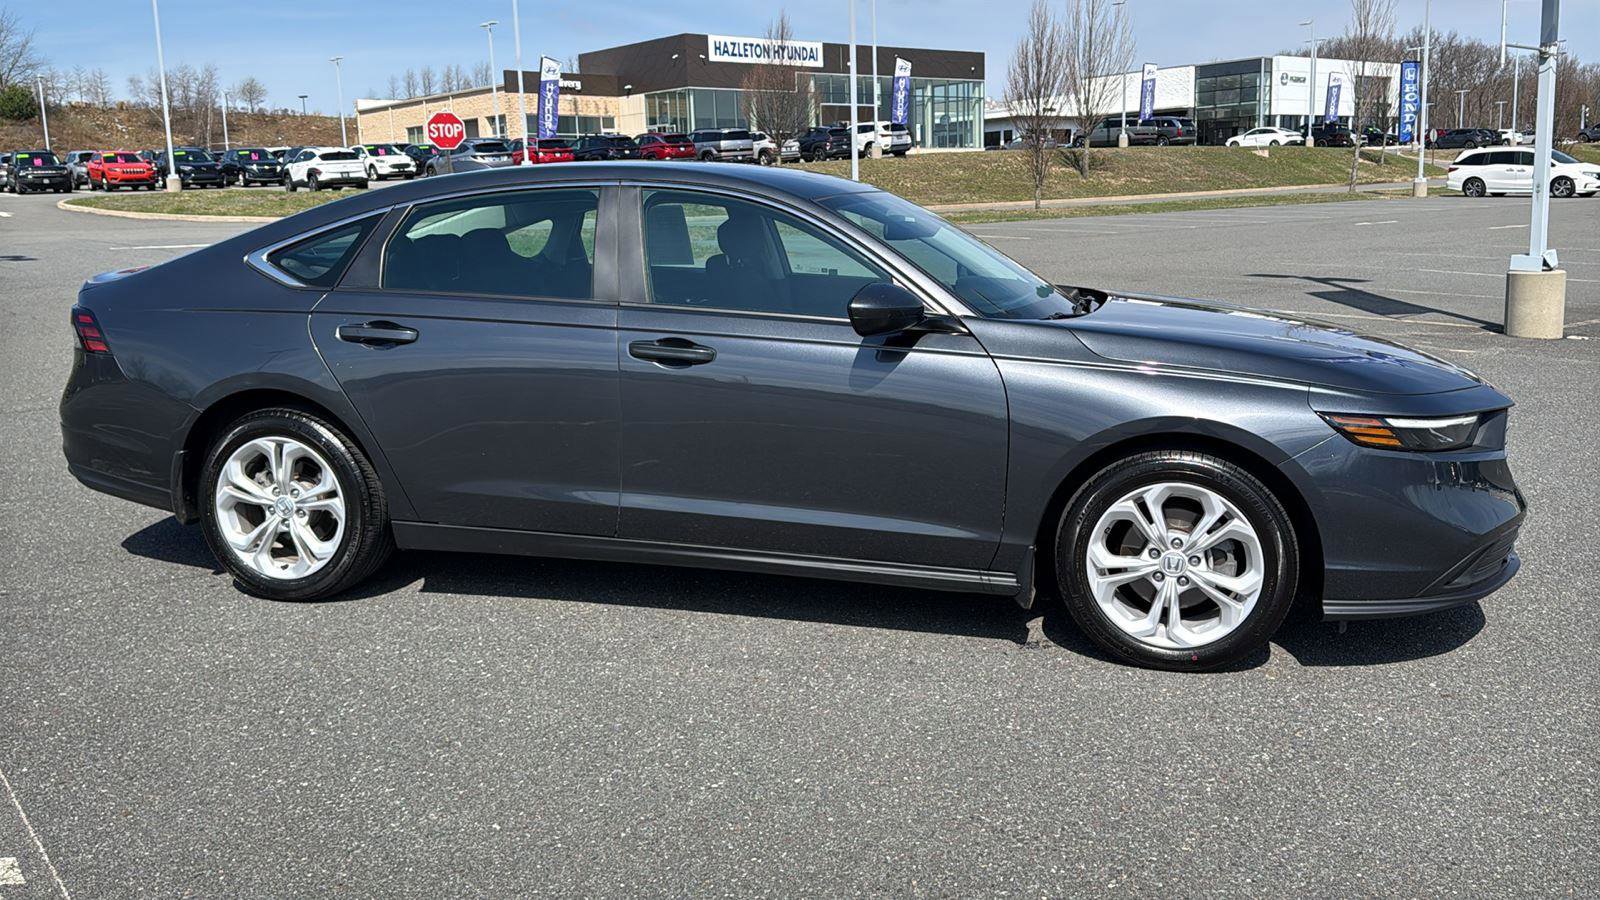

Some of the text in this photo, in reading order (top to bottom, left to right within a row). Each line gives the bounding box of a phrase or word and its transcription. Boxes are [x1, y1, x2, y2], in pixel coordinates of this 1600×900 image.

[714, 41, 818, 61] HAZLETON HYUNDAI
[544, 82, 554, 136] HYUNDAI
[1403, 84, 1418, 133] HONDA
[430, 123, 463, 138] STOP
